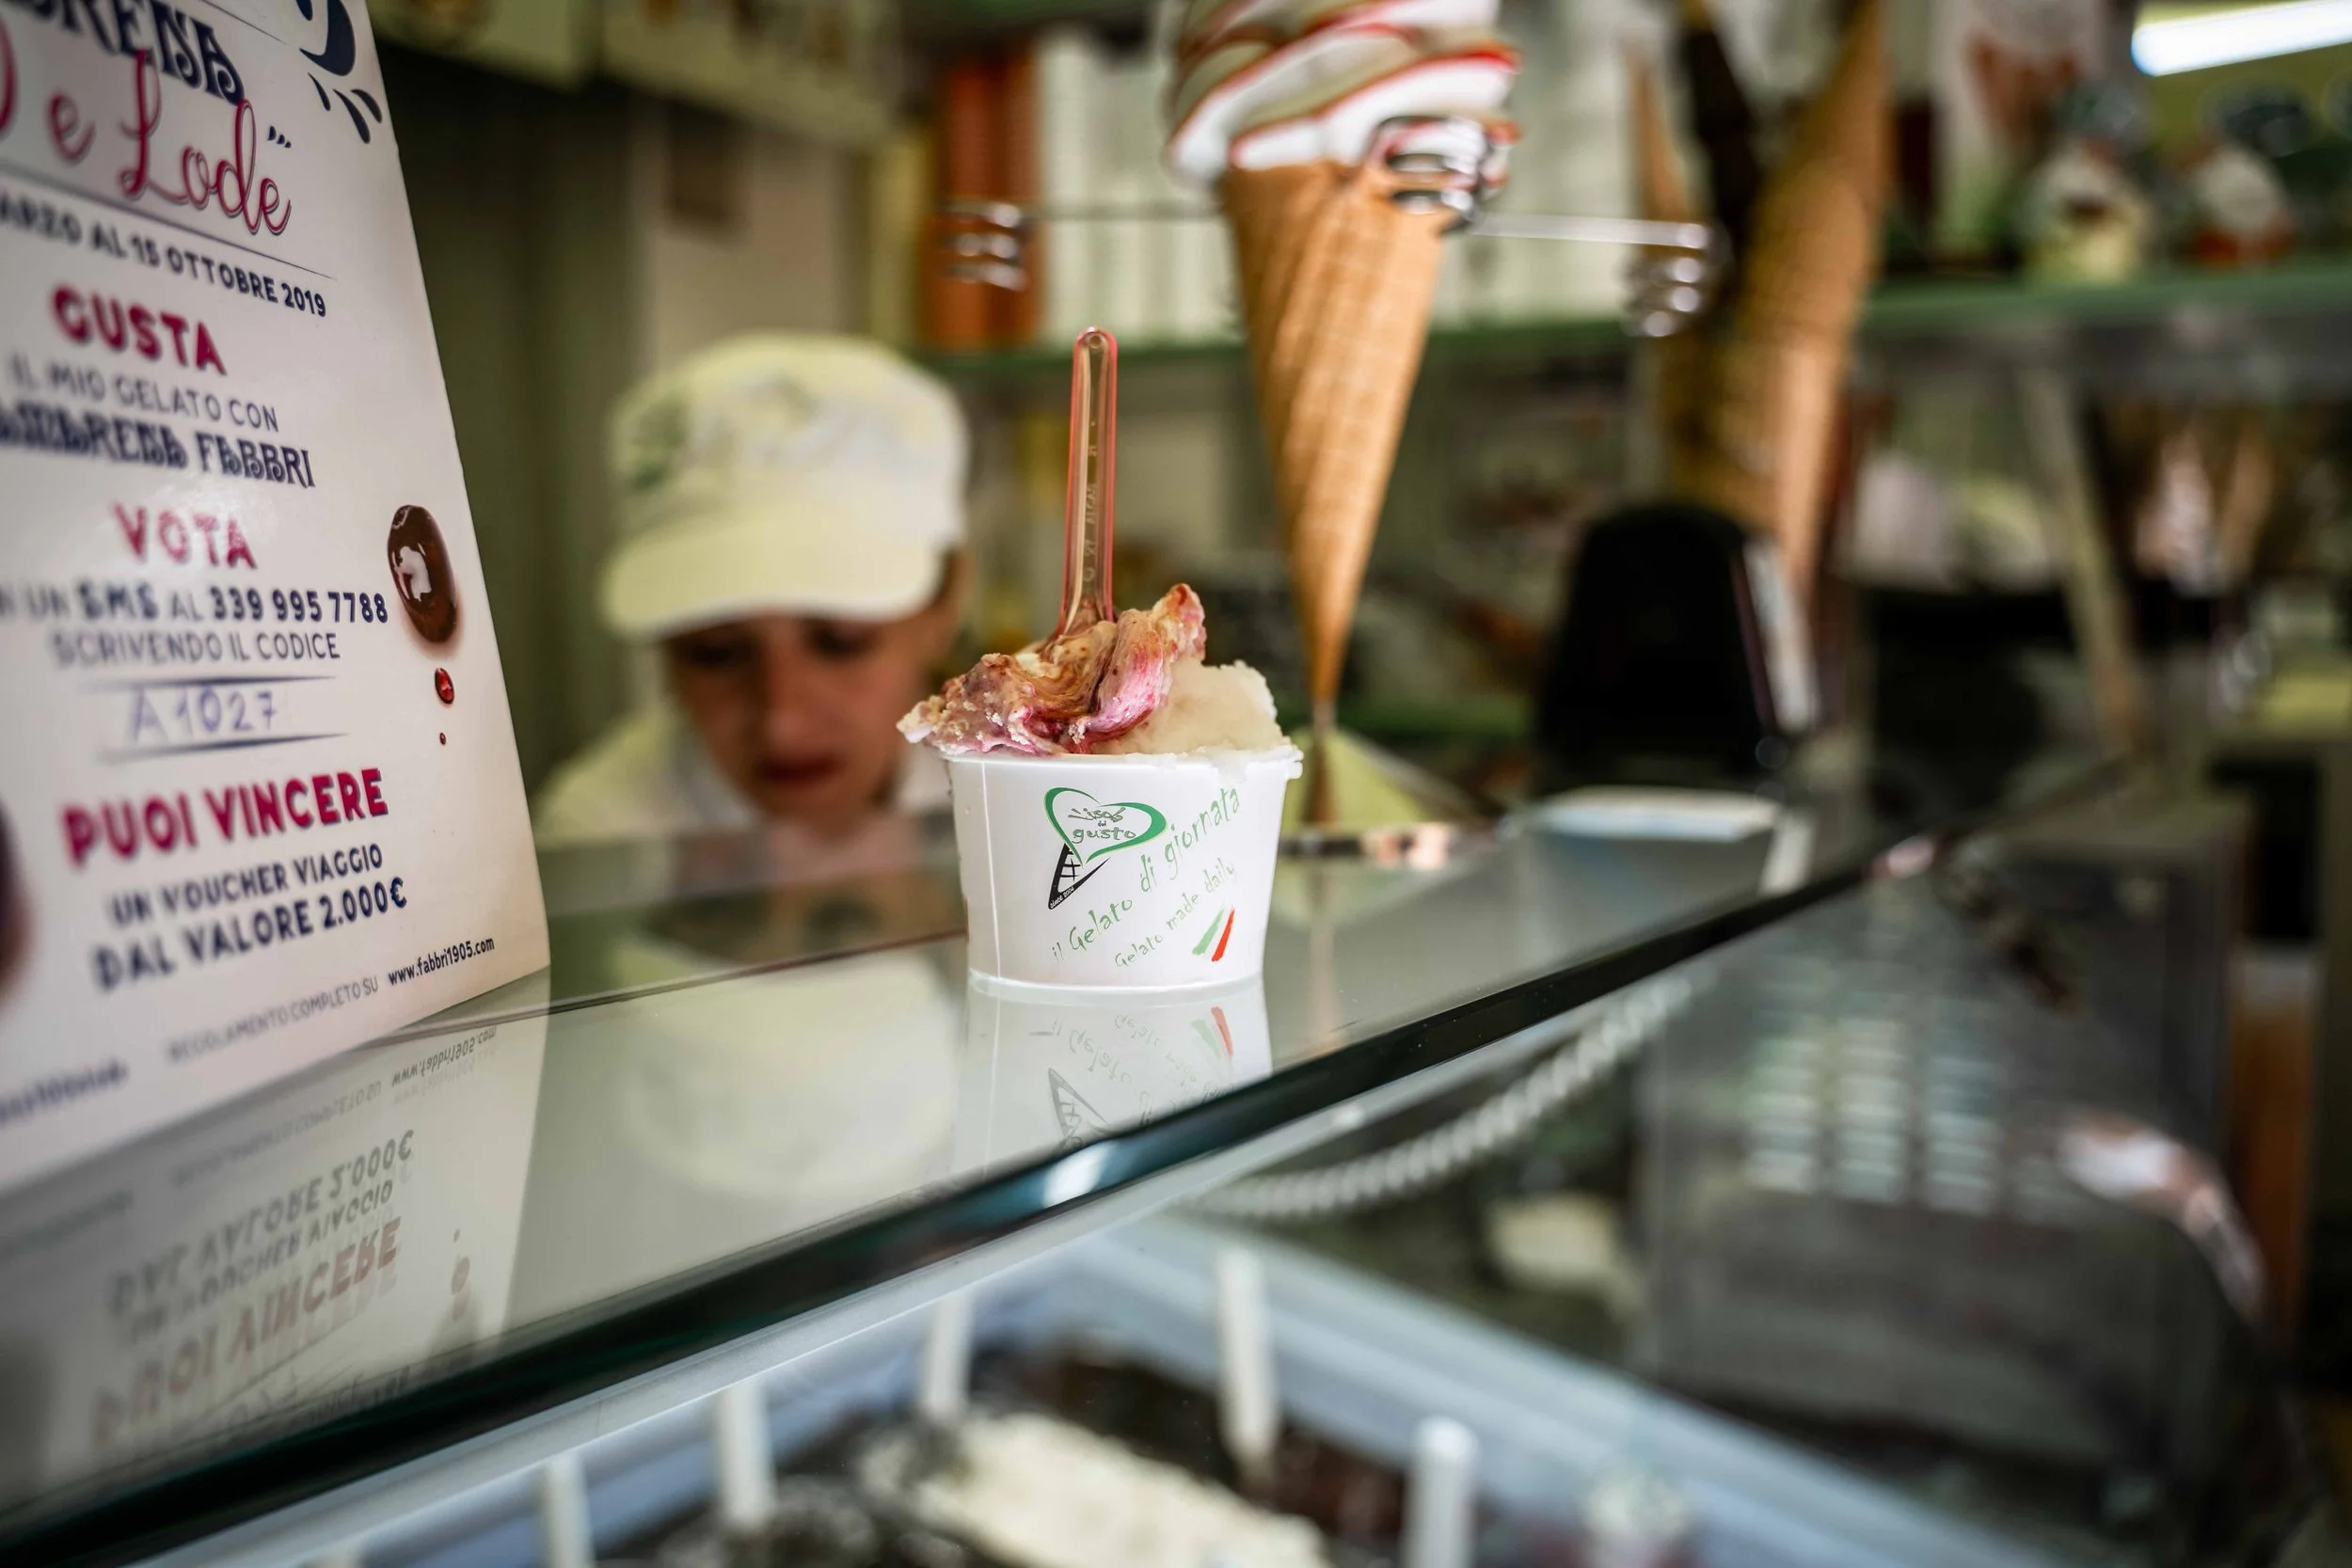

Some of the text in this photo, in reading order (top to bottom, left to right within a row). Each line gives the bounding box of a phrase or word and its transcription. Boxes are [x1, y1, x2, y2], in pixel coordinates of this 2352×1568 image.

[119, 49, 292, 235] Lode
[91, 221, 128, 259] AL
[131, 233, 160, 268] 15
[167, 245, 278, 303] OTTOBRE
[281, 282, 327, 318] 2019
[52, 283, 228, 376] GUSTA
[50, 361, 106, 403] MIO
[116, 374, 221, 421] GELATO
[230, 402, 279, 433] CON
[195, 431, 316, 488] FABBRI
[114, 503, 258, 570] VOTA
[76, 578, 158, 621] SMS
[171, 590, 203, 622] AL
[210, 587, 264, 621] 339
[272, 588, 323, 622] 995
[327, 590, 389, 624] 7788
[52, 631, 342, 669] SCRIVENDO IL CODICE
[132, 684, 278, 741] A1027
[63, 767, 389, 872] PUOI VINCERE
[1072, 826, 1136, 844] gusto
[111, 843, 383, 927] UN VOUCHER VIAGGIO
[1052, 787, 1240, 962] il Gelato di giornata
[1115, 857, 1238, 967] Gelato made daily
[93, 876, 407, 990] DAL VALORE 2.000€
[291, 981, 361, 1022] COMPLETO
[362, 975, 379, 995] SU
[388, 937, 495, 986] www.fabbri1905.com
